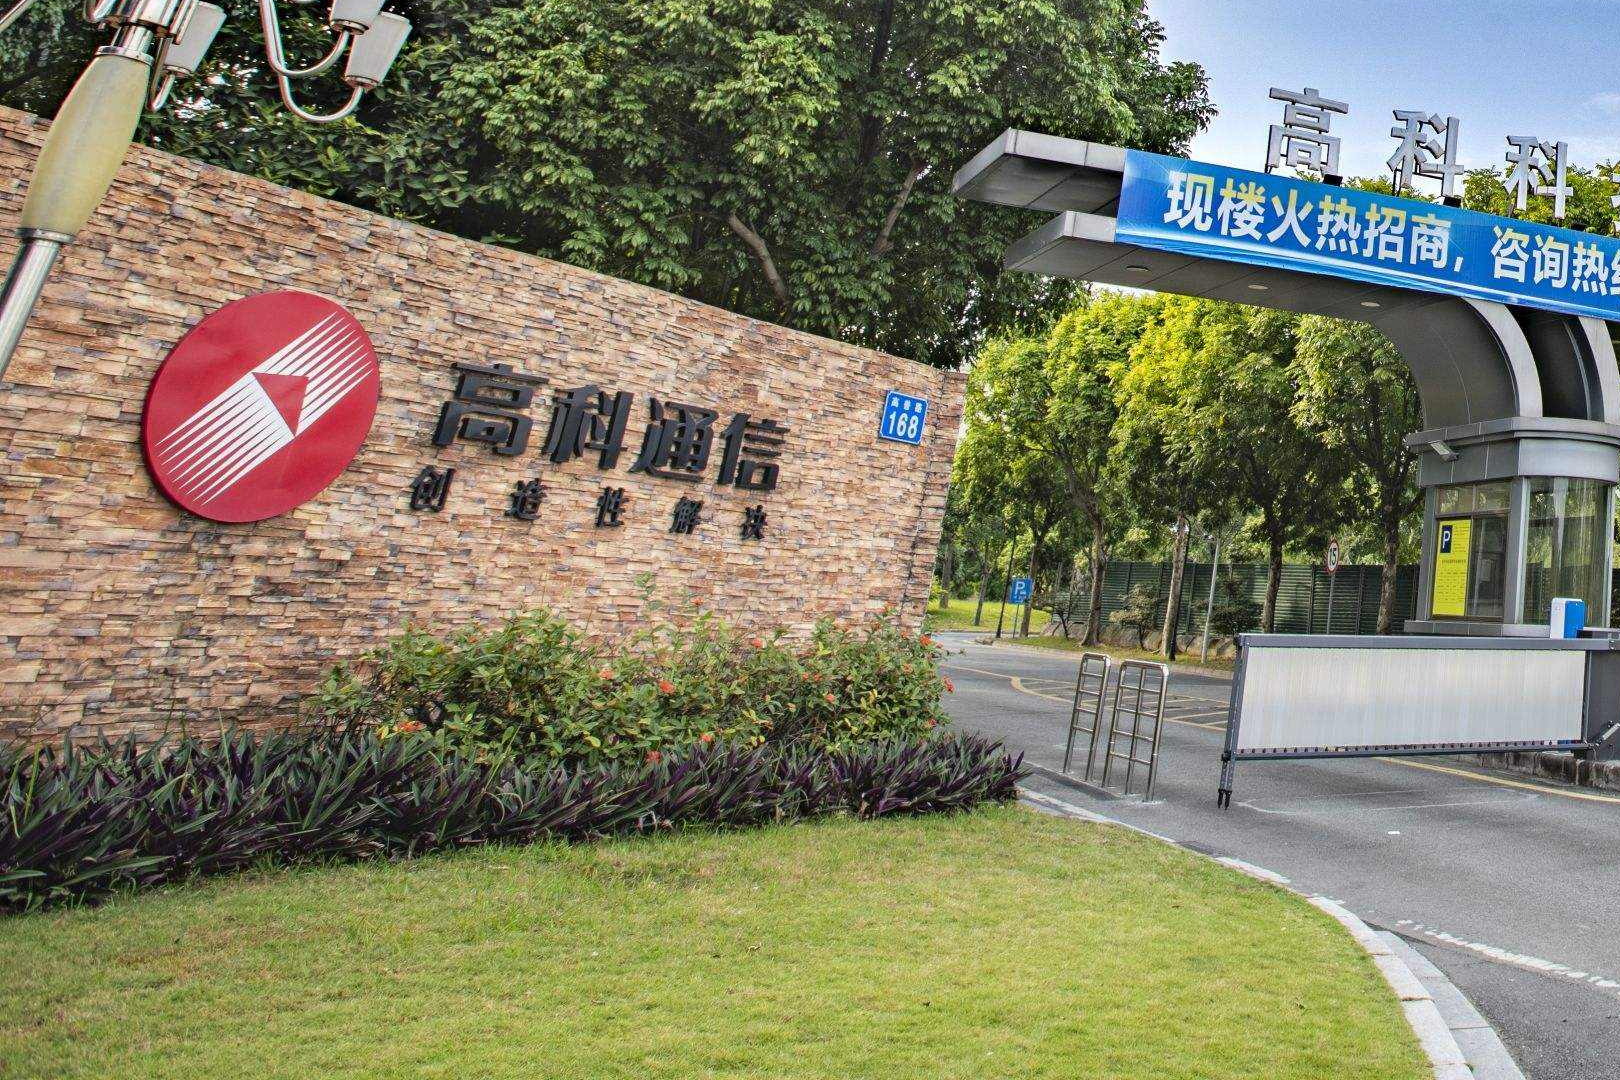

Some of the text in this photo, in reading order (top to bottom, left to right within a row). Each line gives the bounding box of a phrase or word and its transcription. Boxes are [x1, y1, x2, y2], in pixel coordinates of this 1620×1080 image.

[432, 363, 791, 491] 高科通信
[889, 411, 918, 438] 168
[409, 465, 768, 541] 创造性解决
[1442, 530, 1451, 549] P
[1330, 547, 1337, 566] 15
[1015, 581, 1025, 595] P
